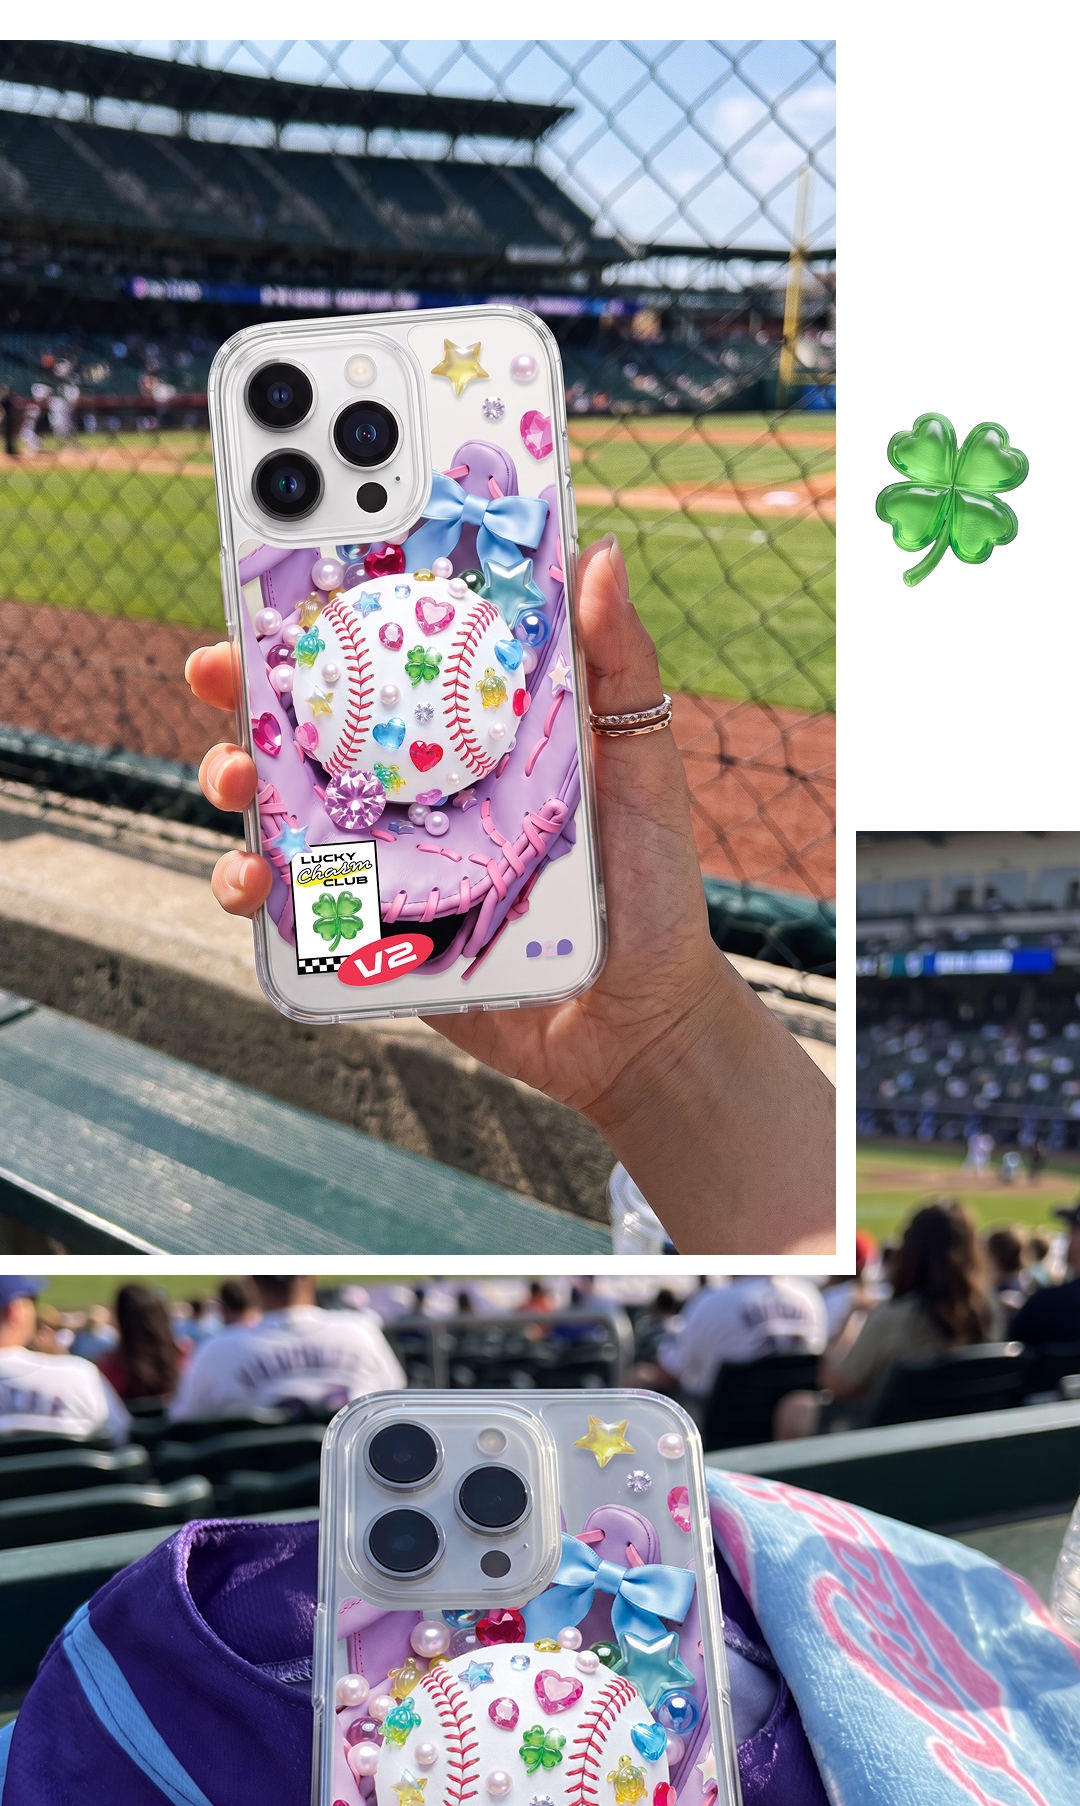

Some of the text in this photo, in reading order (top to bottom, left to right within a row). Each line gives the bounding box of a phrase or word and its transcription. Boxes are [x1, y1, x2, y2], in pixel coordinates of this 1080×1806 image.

[301, 852, 356, 864] LUCKY
[297, 860, 373, 884] Charm
[323, 876, 368, 887] CLUB
[353, 941, 418, 978] V2
